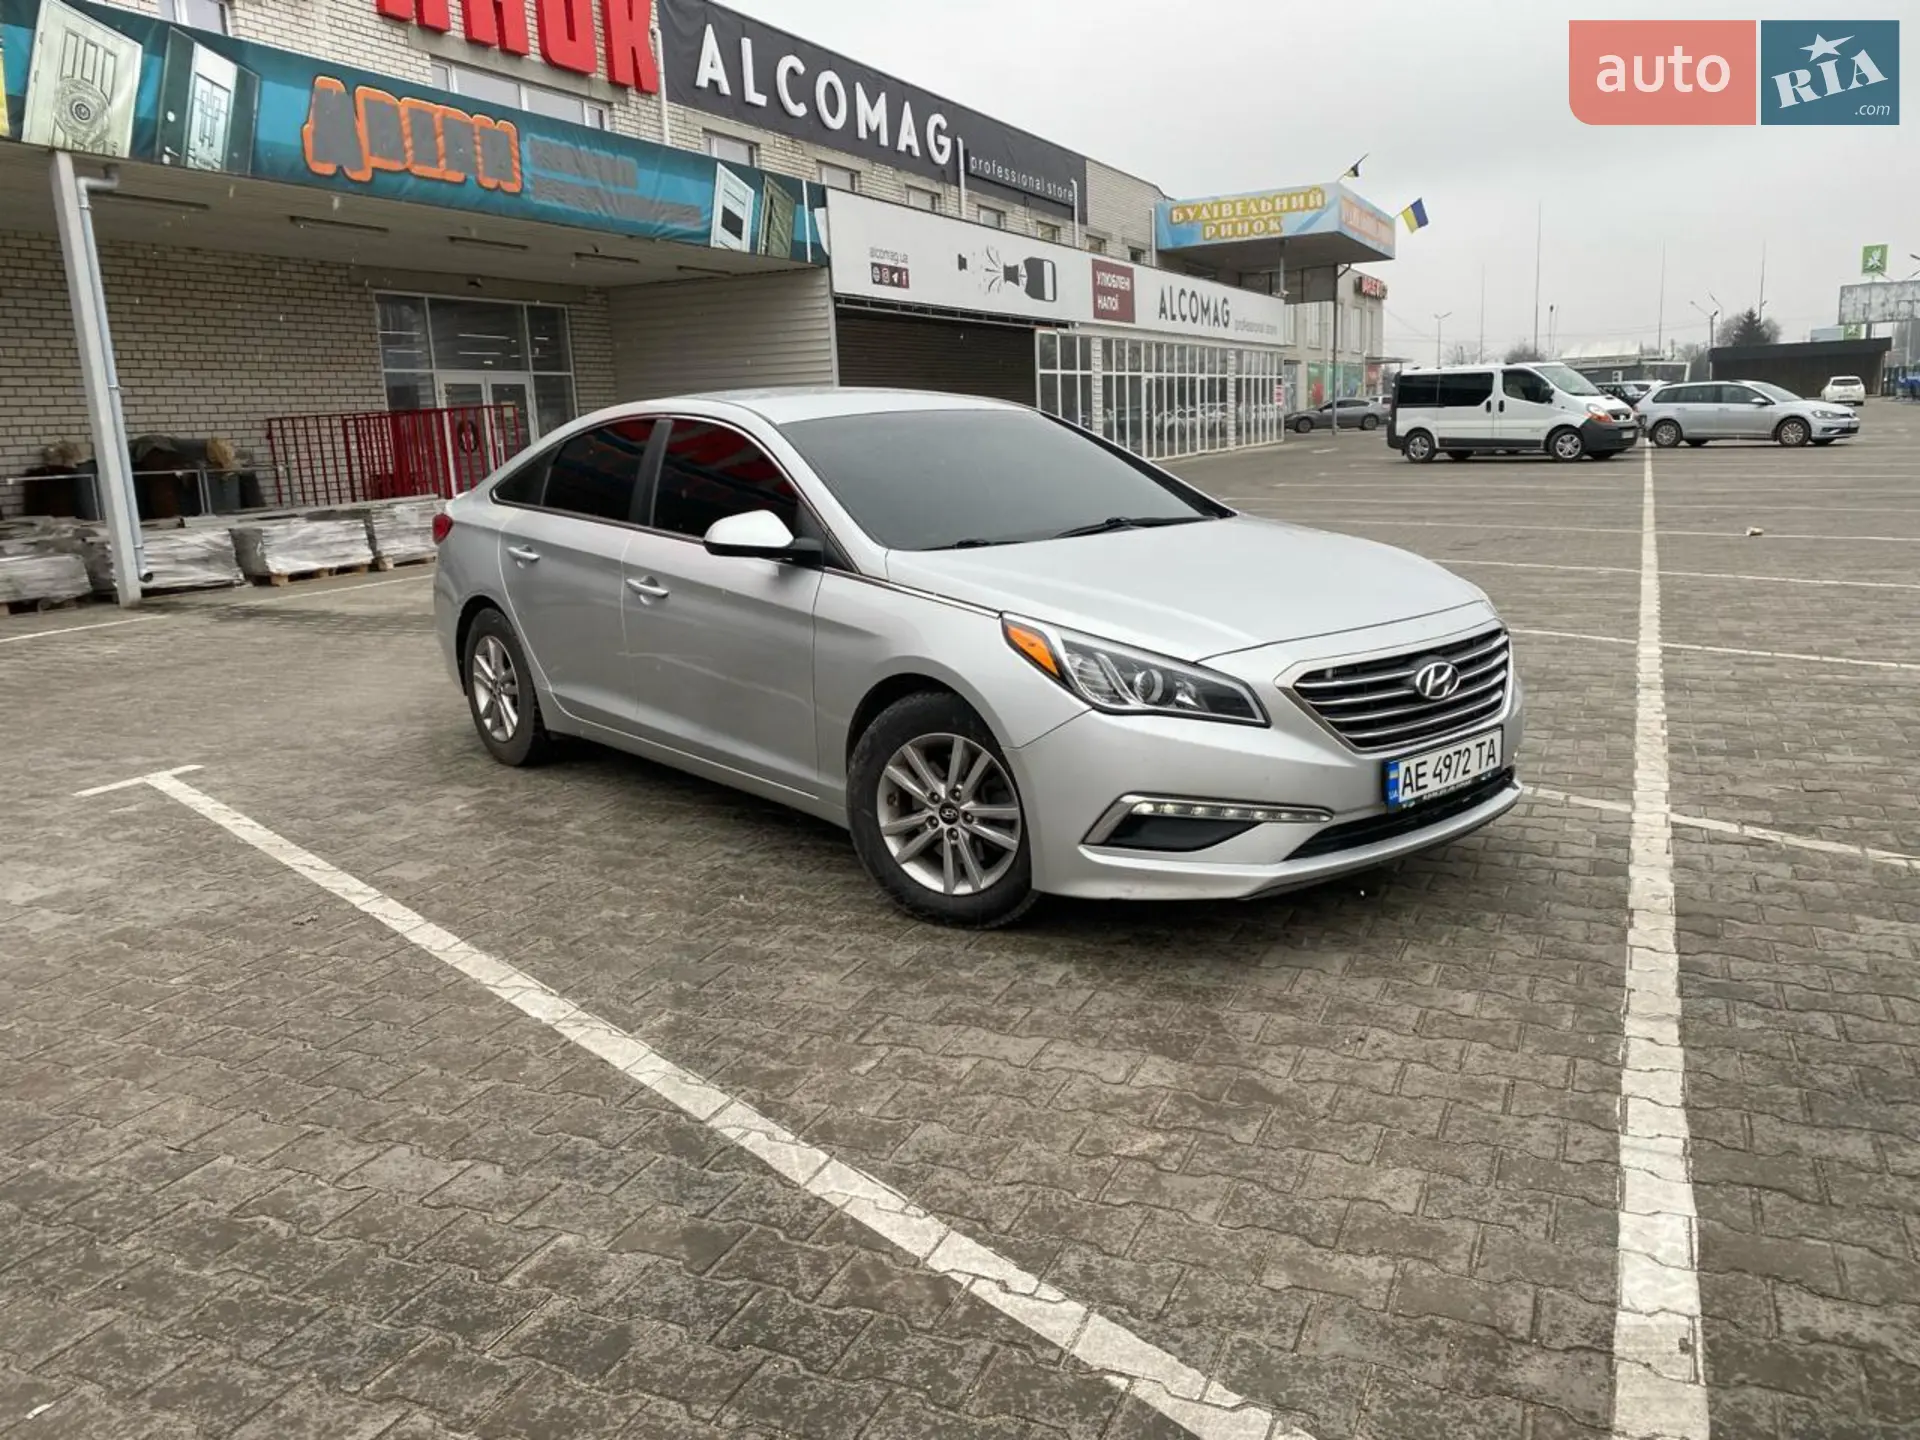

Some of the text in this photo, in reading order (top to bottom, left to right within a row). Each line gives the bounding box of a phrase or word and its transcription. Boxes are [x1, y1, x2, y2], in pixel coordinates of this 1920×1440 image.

[695, 23, 951, 165] ALCOMAG
[969, 155, 1074, 201] professional store
[1171, 187, 1325, 224] БУДІВЕЛЬНИЙ
[1204, 216, 1283, 240] РИНОК
[1158, 284, 1231, 328] ALCOMAG
[1401, 760, 1429, 796] AE
[1432, 747, 1472, 784] 4972
[1475, 738, 1497, 769] TA
